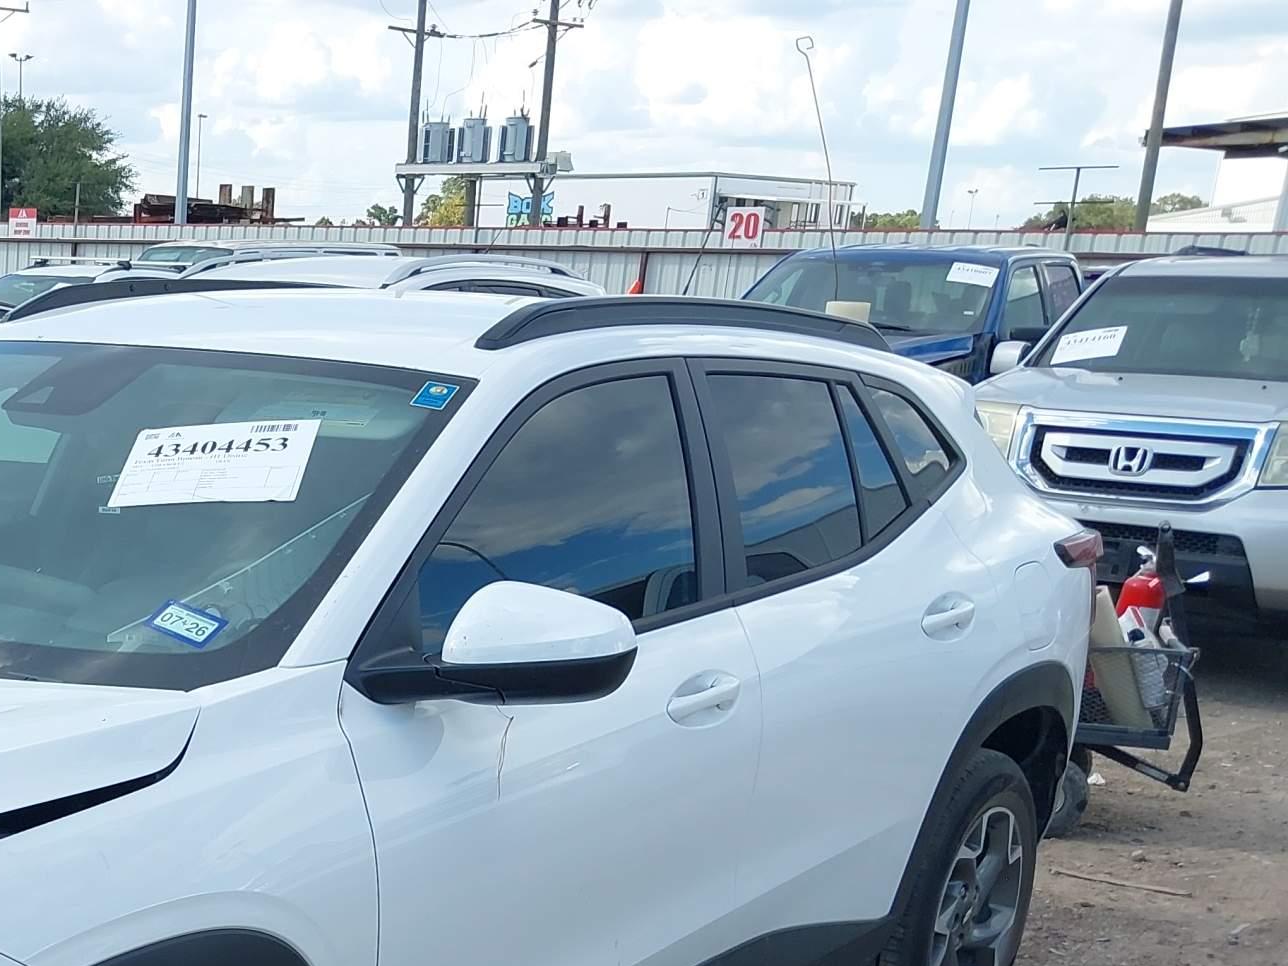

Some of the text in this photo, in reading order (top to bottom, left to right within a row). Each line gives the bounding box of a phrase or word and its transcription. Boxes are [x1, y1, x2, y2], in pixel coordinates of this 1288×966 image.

[507, 191, 554, 214] BOK
[506, 214, 553, 228] GA
[728, 212, 760, 239] 20
[147, 437, 289, 458] 43404453
